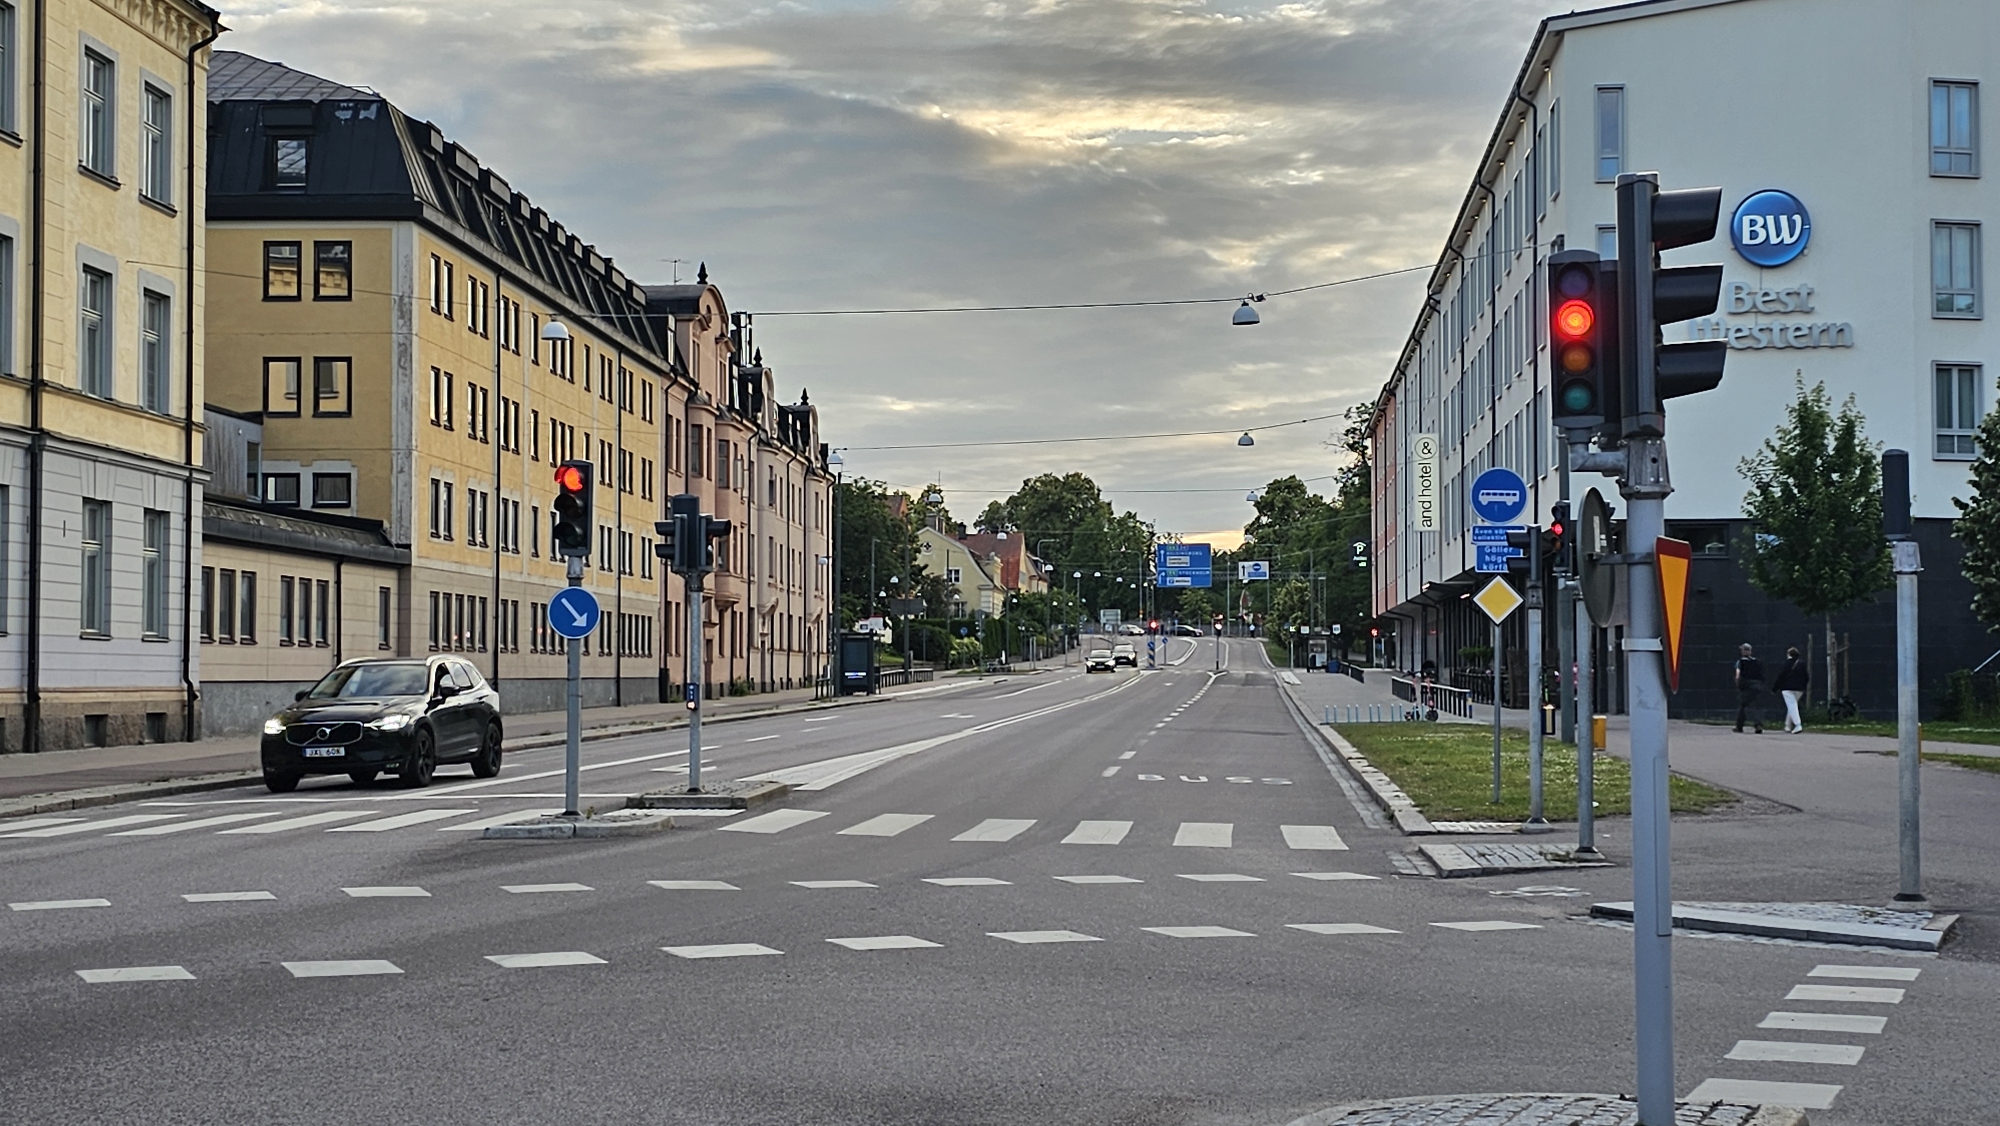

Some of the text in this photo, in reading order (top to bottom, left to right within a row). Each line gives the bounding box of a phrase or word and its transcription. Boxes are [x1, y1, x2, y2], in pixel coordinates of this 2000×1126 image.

[1742, 214, 1802, 245] BW
[1726, 281, 1815, 315] Best
[1687, 318, 1855, 350] Western
[1484, 545, 1513, 553] Gäller
[1485, 554, 1507, 563] höge
[1482, 562, 1507, 571] körfä
[1137, 774, 1293, 786] BUSS
